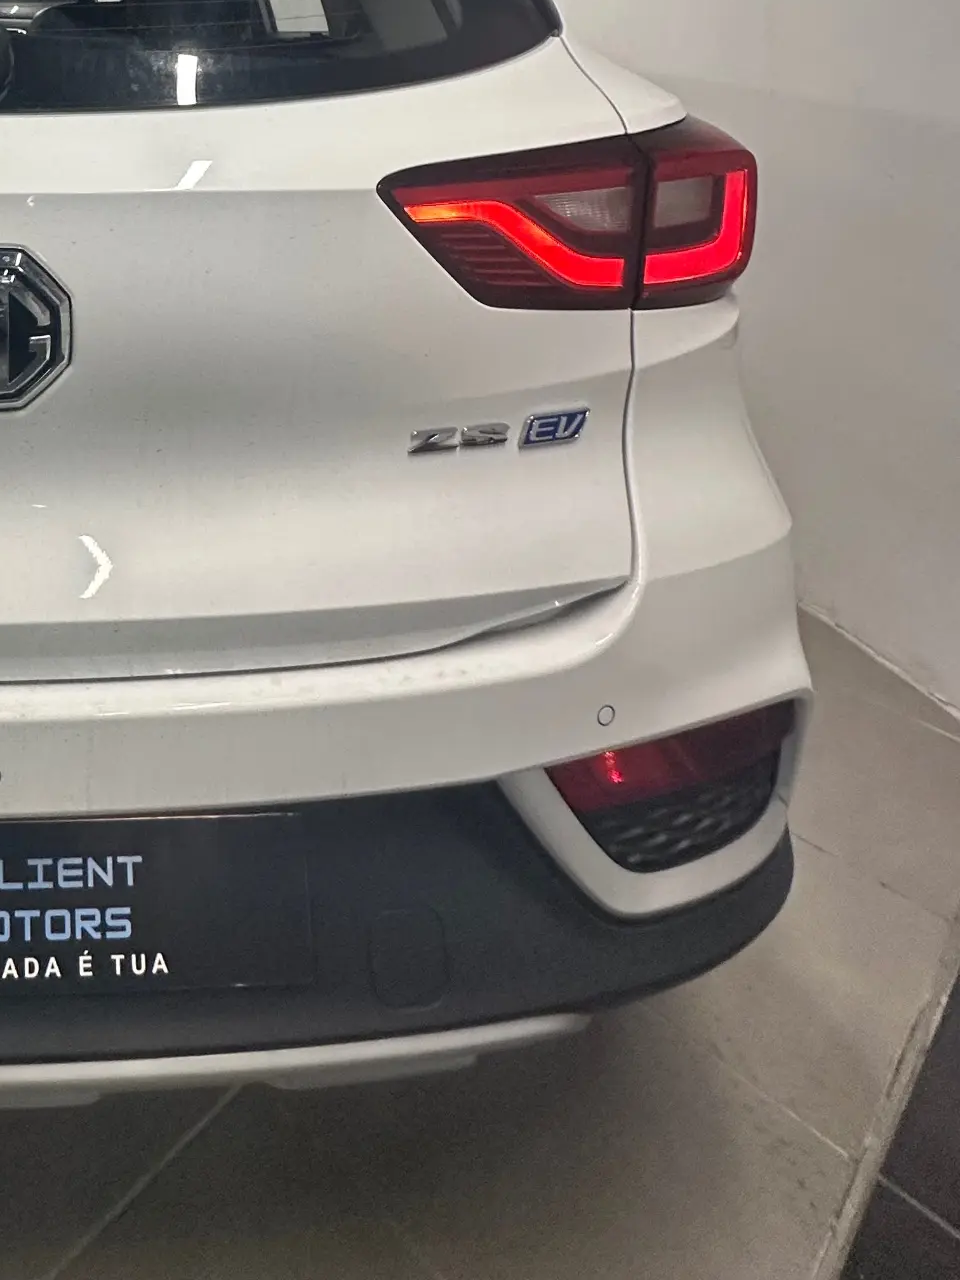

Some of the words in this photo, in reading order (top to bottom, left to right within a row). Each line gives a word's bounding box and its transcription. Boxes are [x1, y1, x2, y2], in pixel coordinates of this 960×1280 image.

[407, 422, 510, 454] ZS
[528, 412, 585, 442] EV
[79, 950, 93, 976] É
[111, 952, 169, 975] TUA
